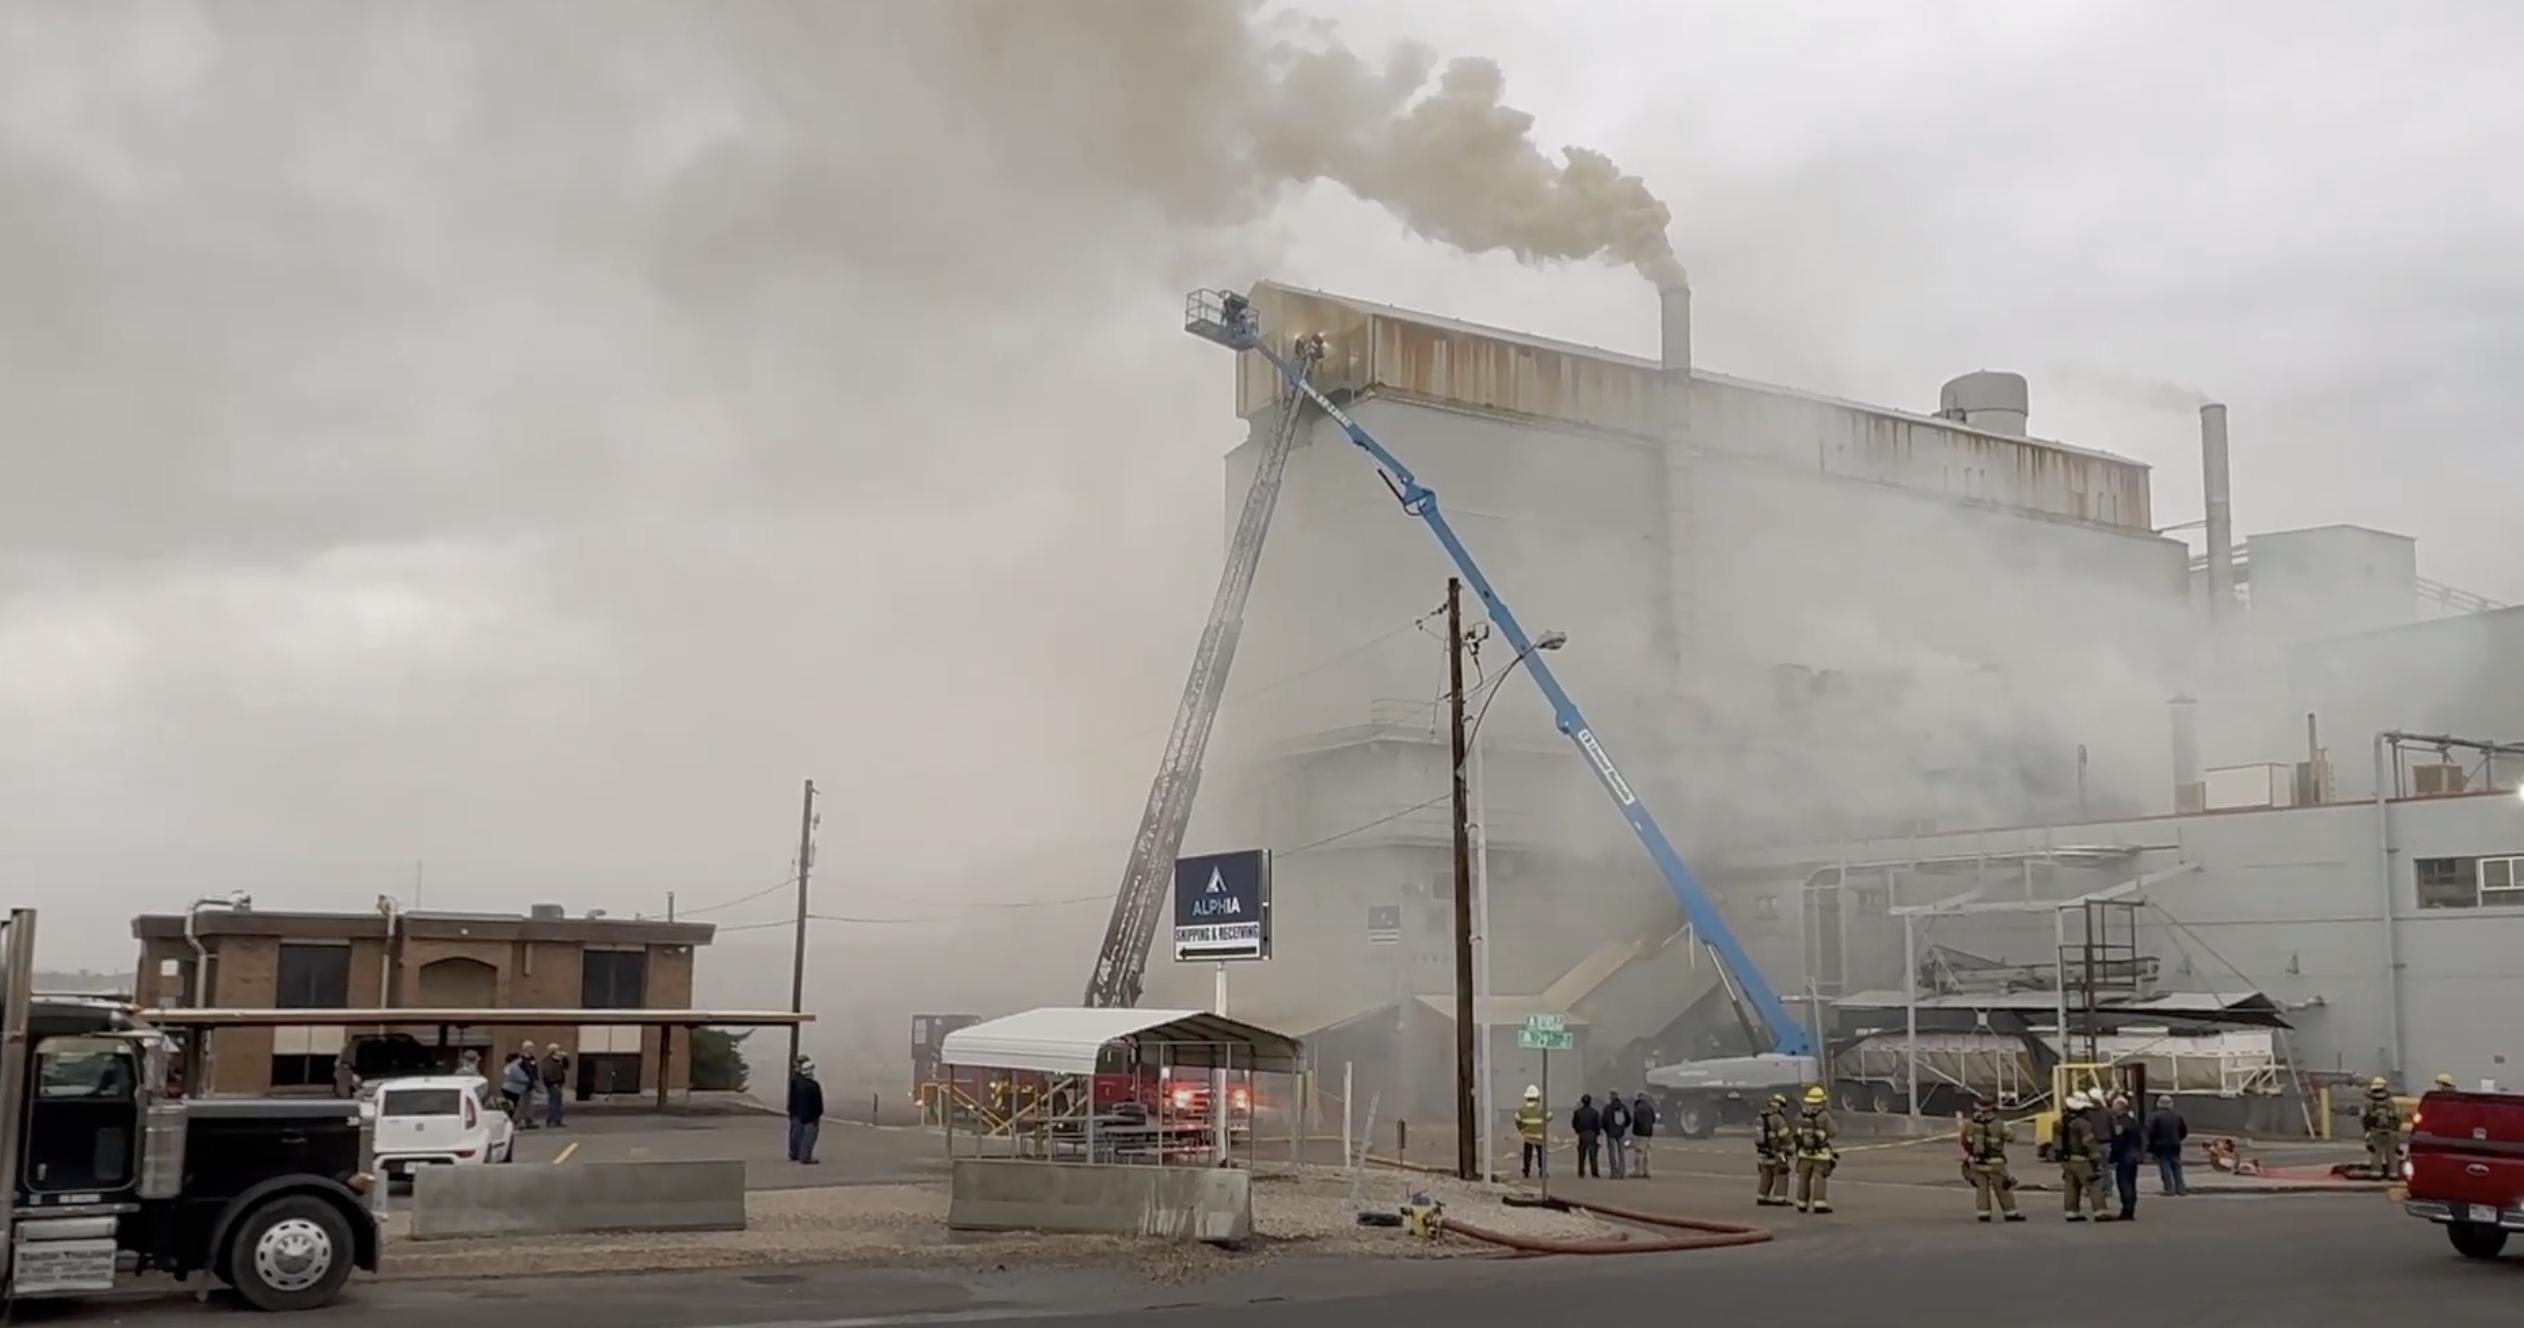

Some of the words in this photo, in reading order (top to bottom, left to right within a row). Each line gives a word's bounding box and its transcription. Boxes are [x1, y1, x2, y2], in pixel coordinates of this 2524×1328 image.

[1192, 896, 1241, 917] ALPHIA
[1175, 927, 1210, 942] SHIPPING
[1211, 926, 1217, 941] &
[1219, 925, 1259, 941] RECEIVING
